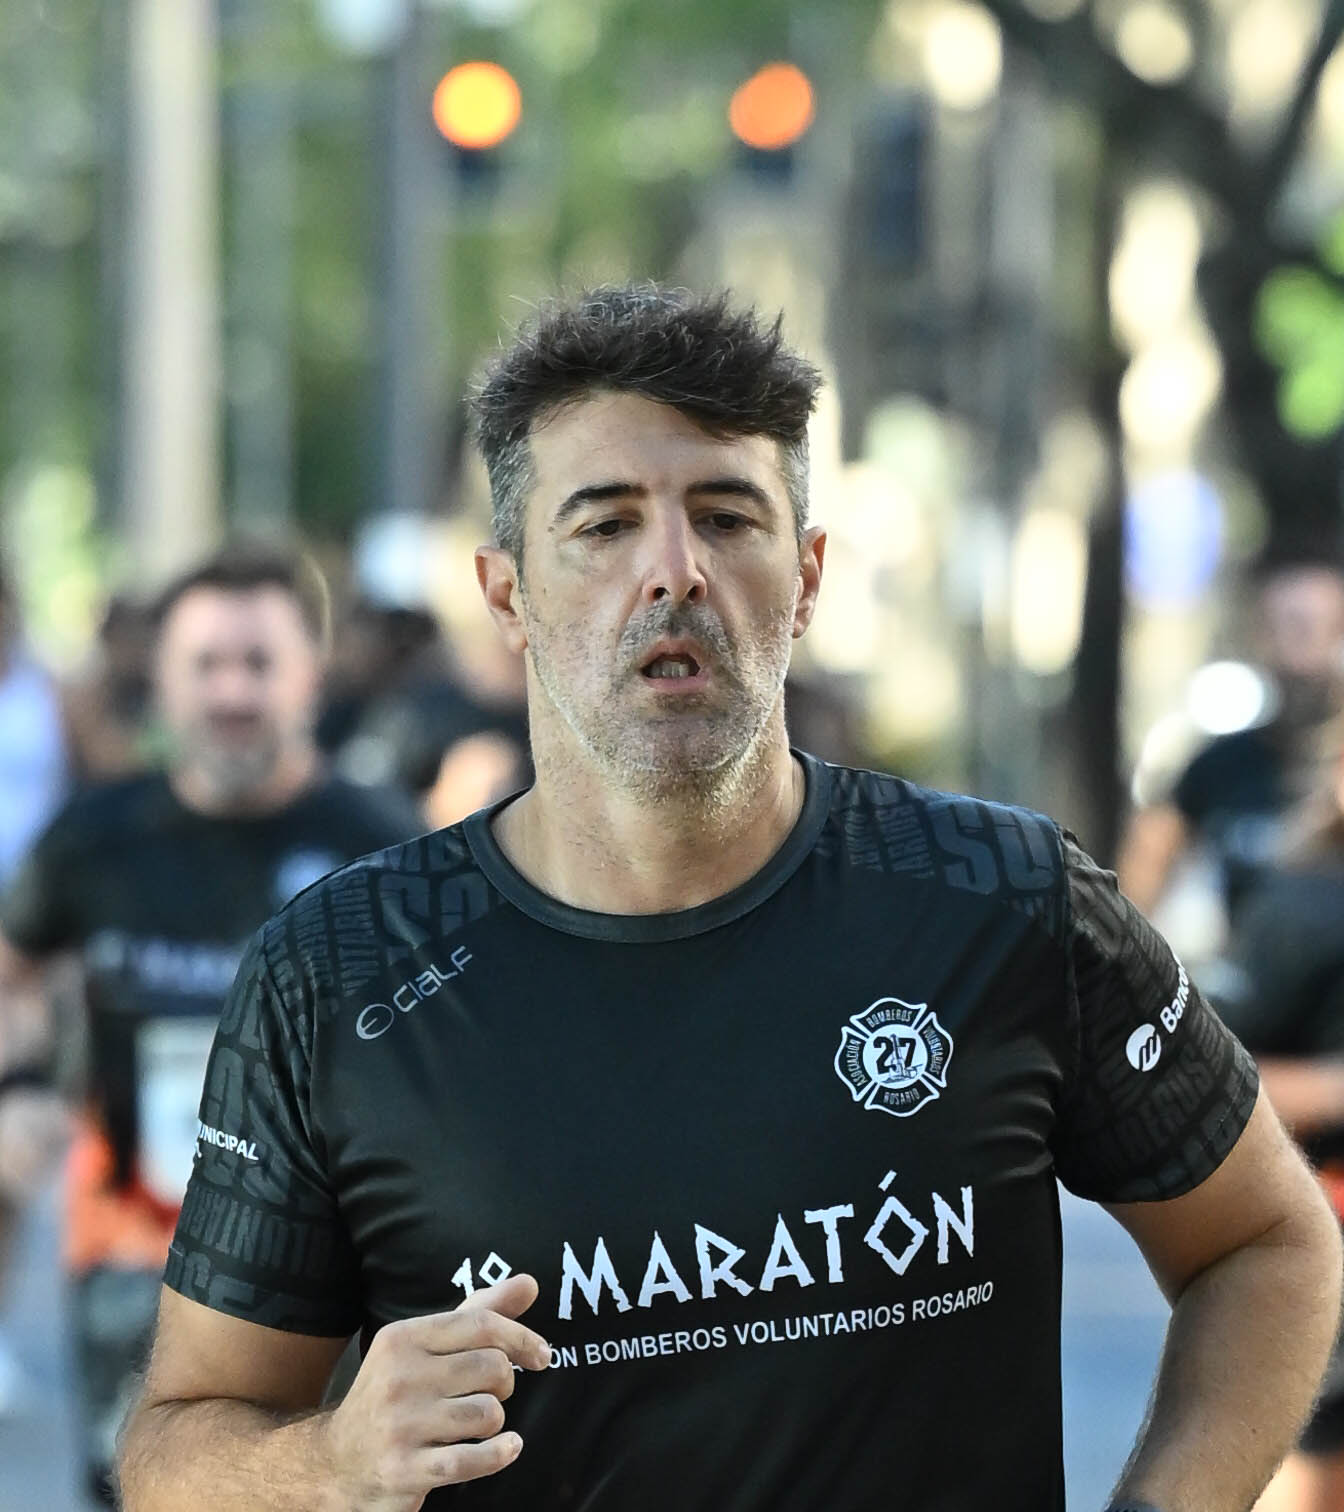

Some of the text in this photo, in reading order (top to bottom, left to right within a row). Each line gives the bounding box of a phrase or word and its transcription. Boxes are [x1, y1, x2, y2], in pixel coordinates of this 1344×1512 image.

[873, 1036, 917, 1075] 27
[883, 1088, 921, 1105] ROSARIO
[558, 1169, 974, 1320] MARATÓN
[585, 1326, 728, 1366] BOMBEROS
[733, 1303, 906, 1345] VOLUNTARIOS
[912, 1281, 994, 1321] ROSARIO
